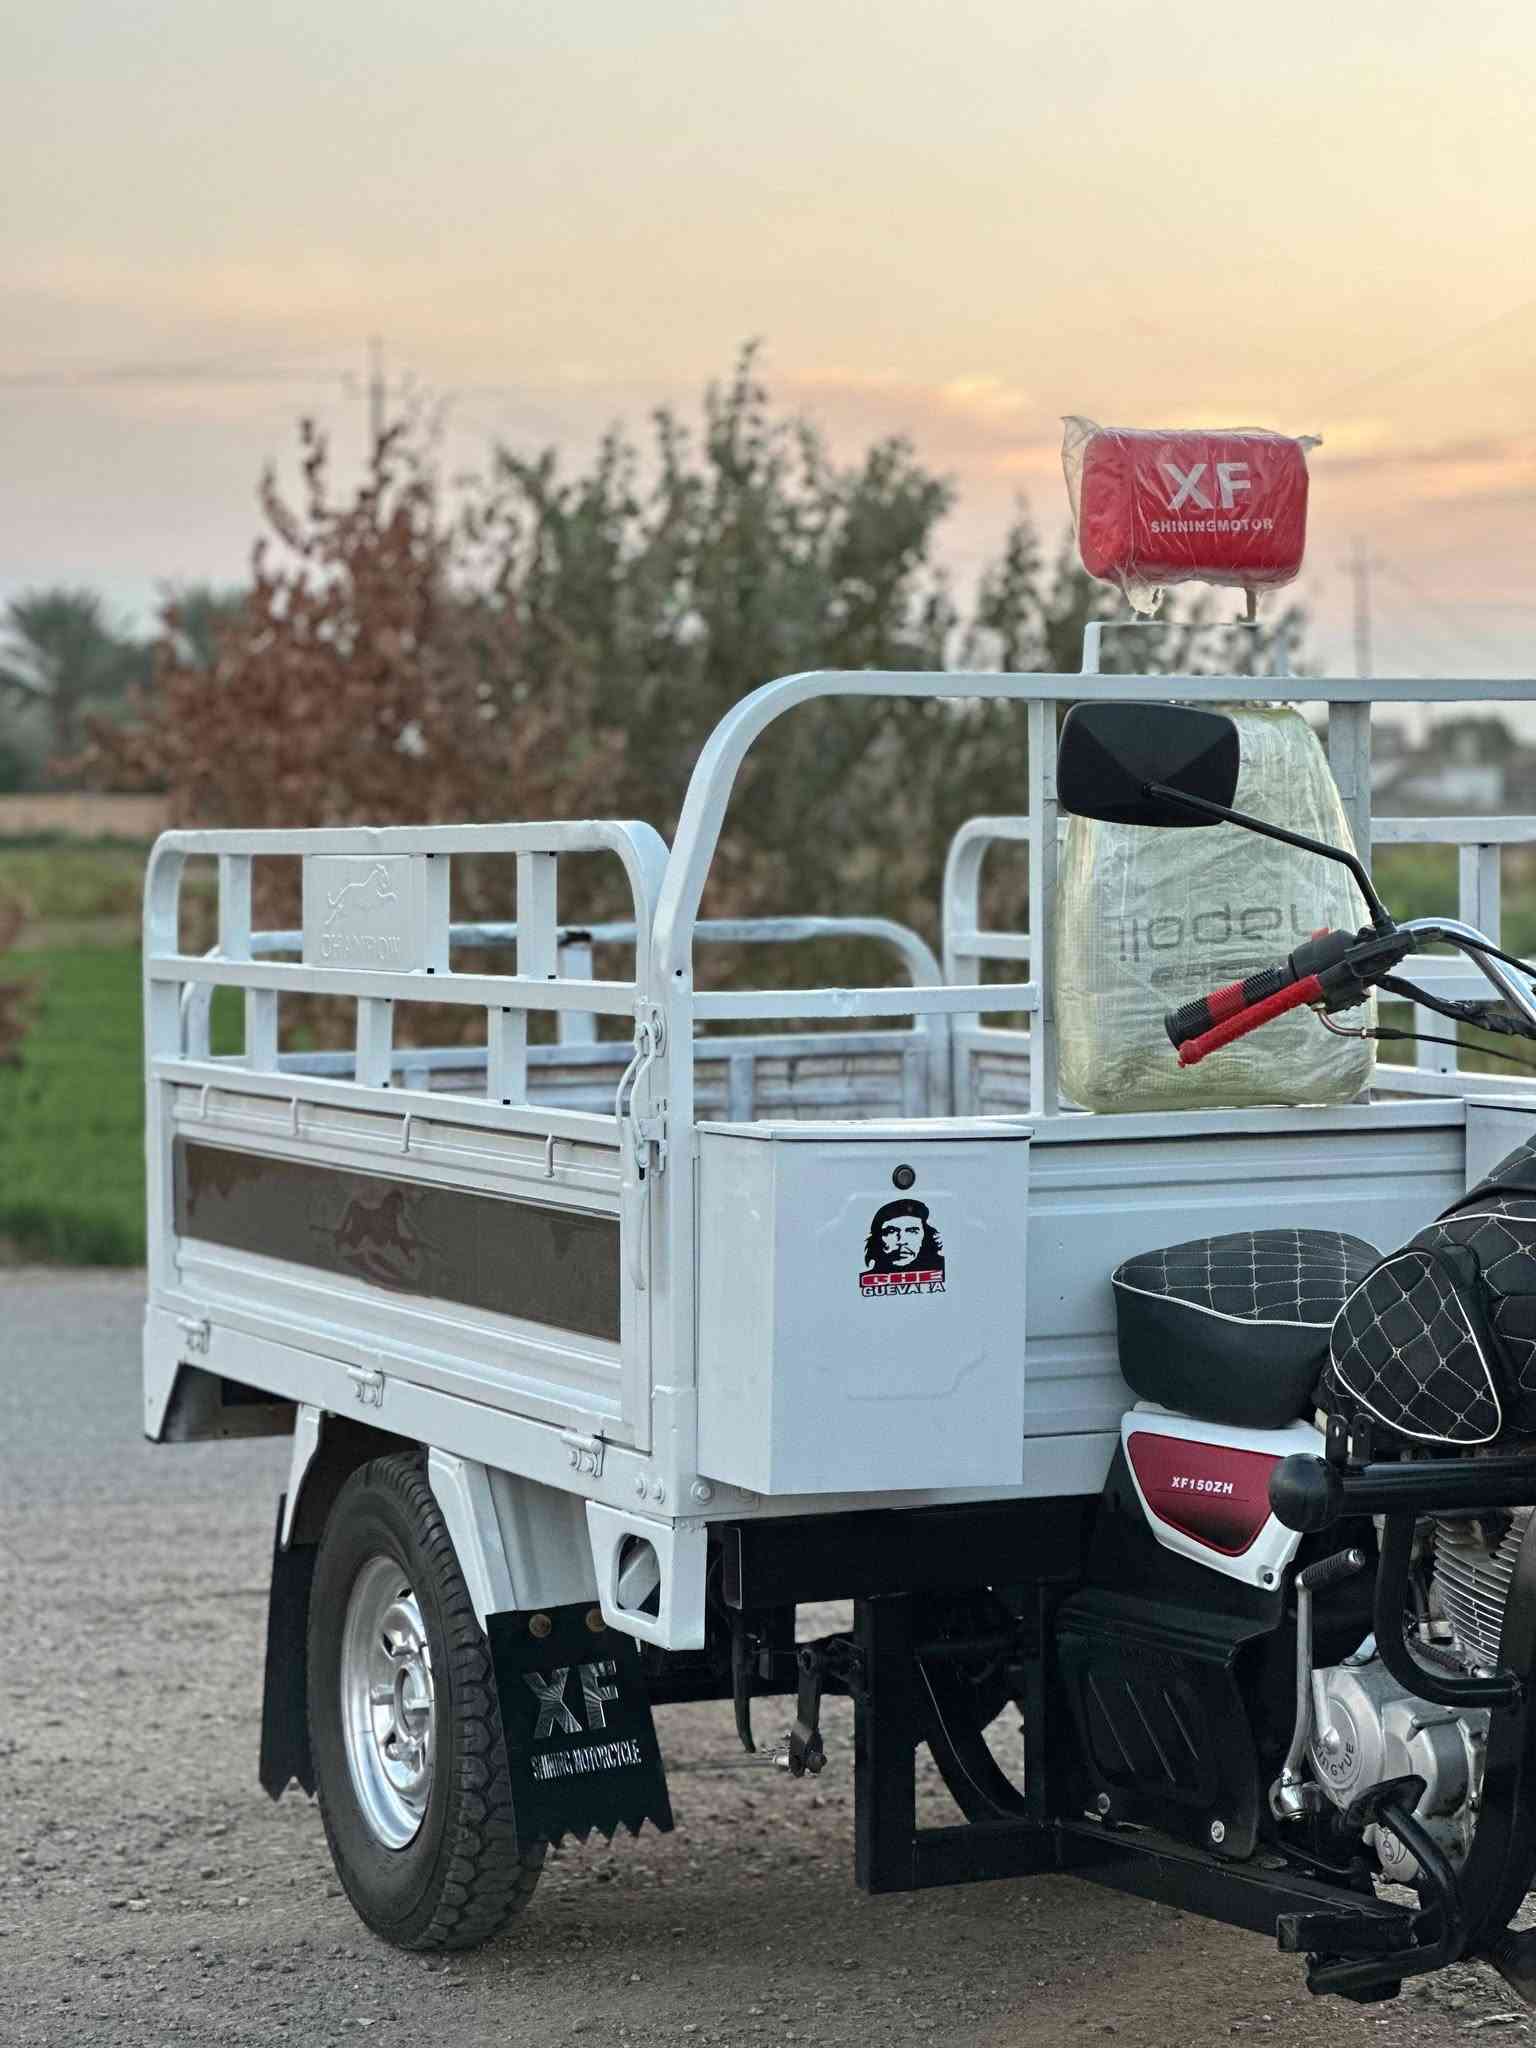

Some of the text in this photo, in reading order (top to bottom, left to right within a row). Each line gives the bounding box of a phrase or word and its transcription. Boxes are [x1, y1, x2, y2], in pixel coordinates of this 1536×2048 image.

[1163, 461, 1252, 511] XF
[1150, 518, 1274, 534] SHININGMOTOR
[1171, 1476, 1234, 1494] XF150ZH
[522, 1659, 619, 1740] XF
[572, 1738, 642, 1776] MOTORCYCLE
